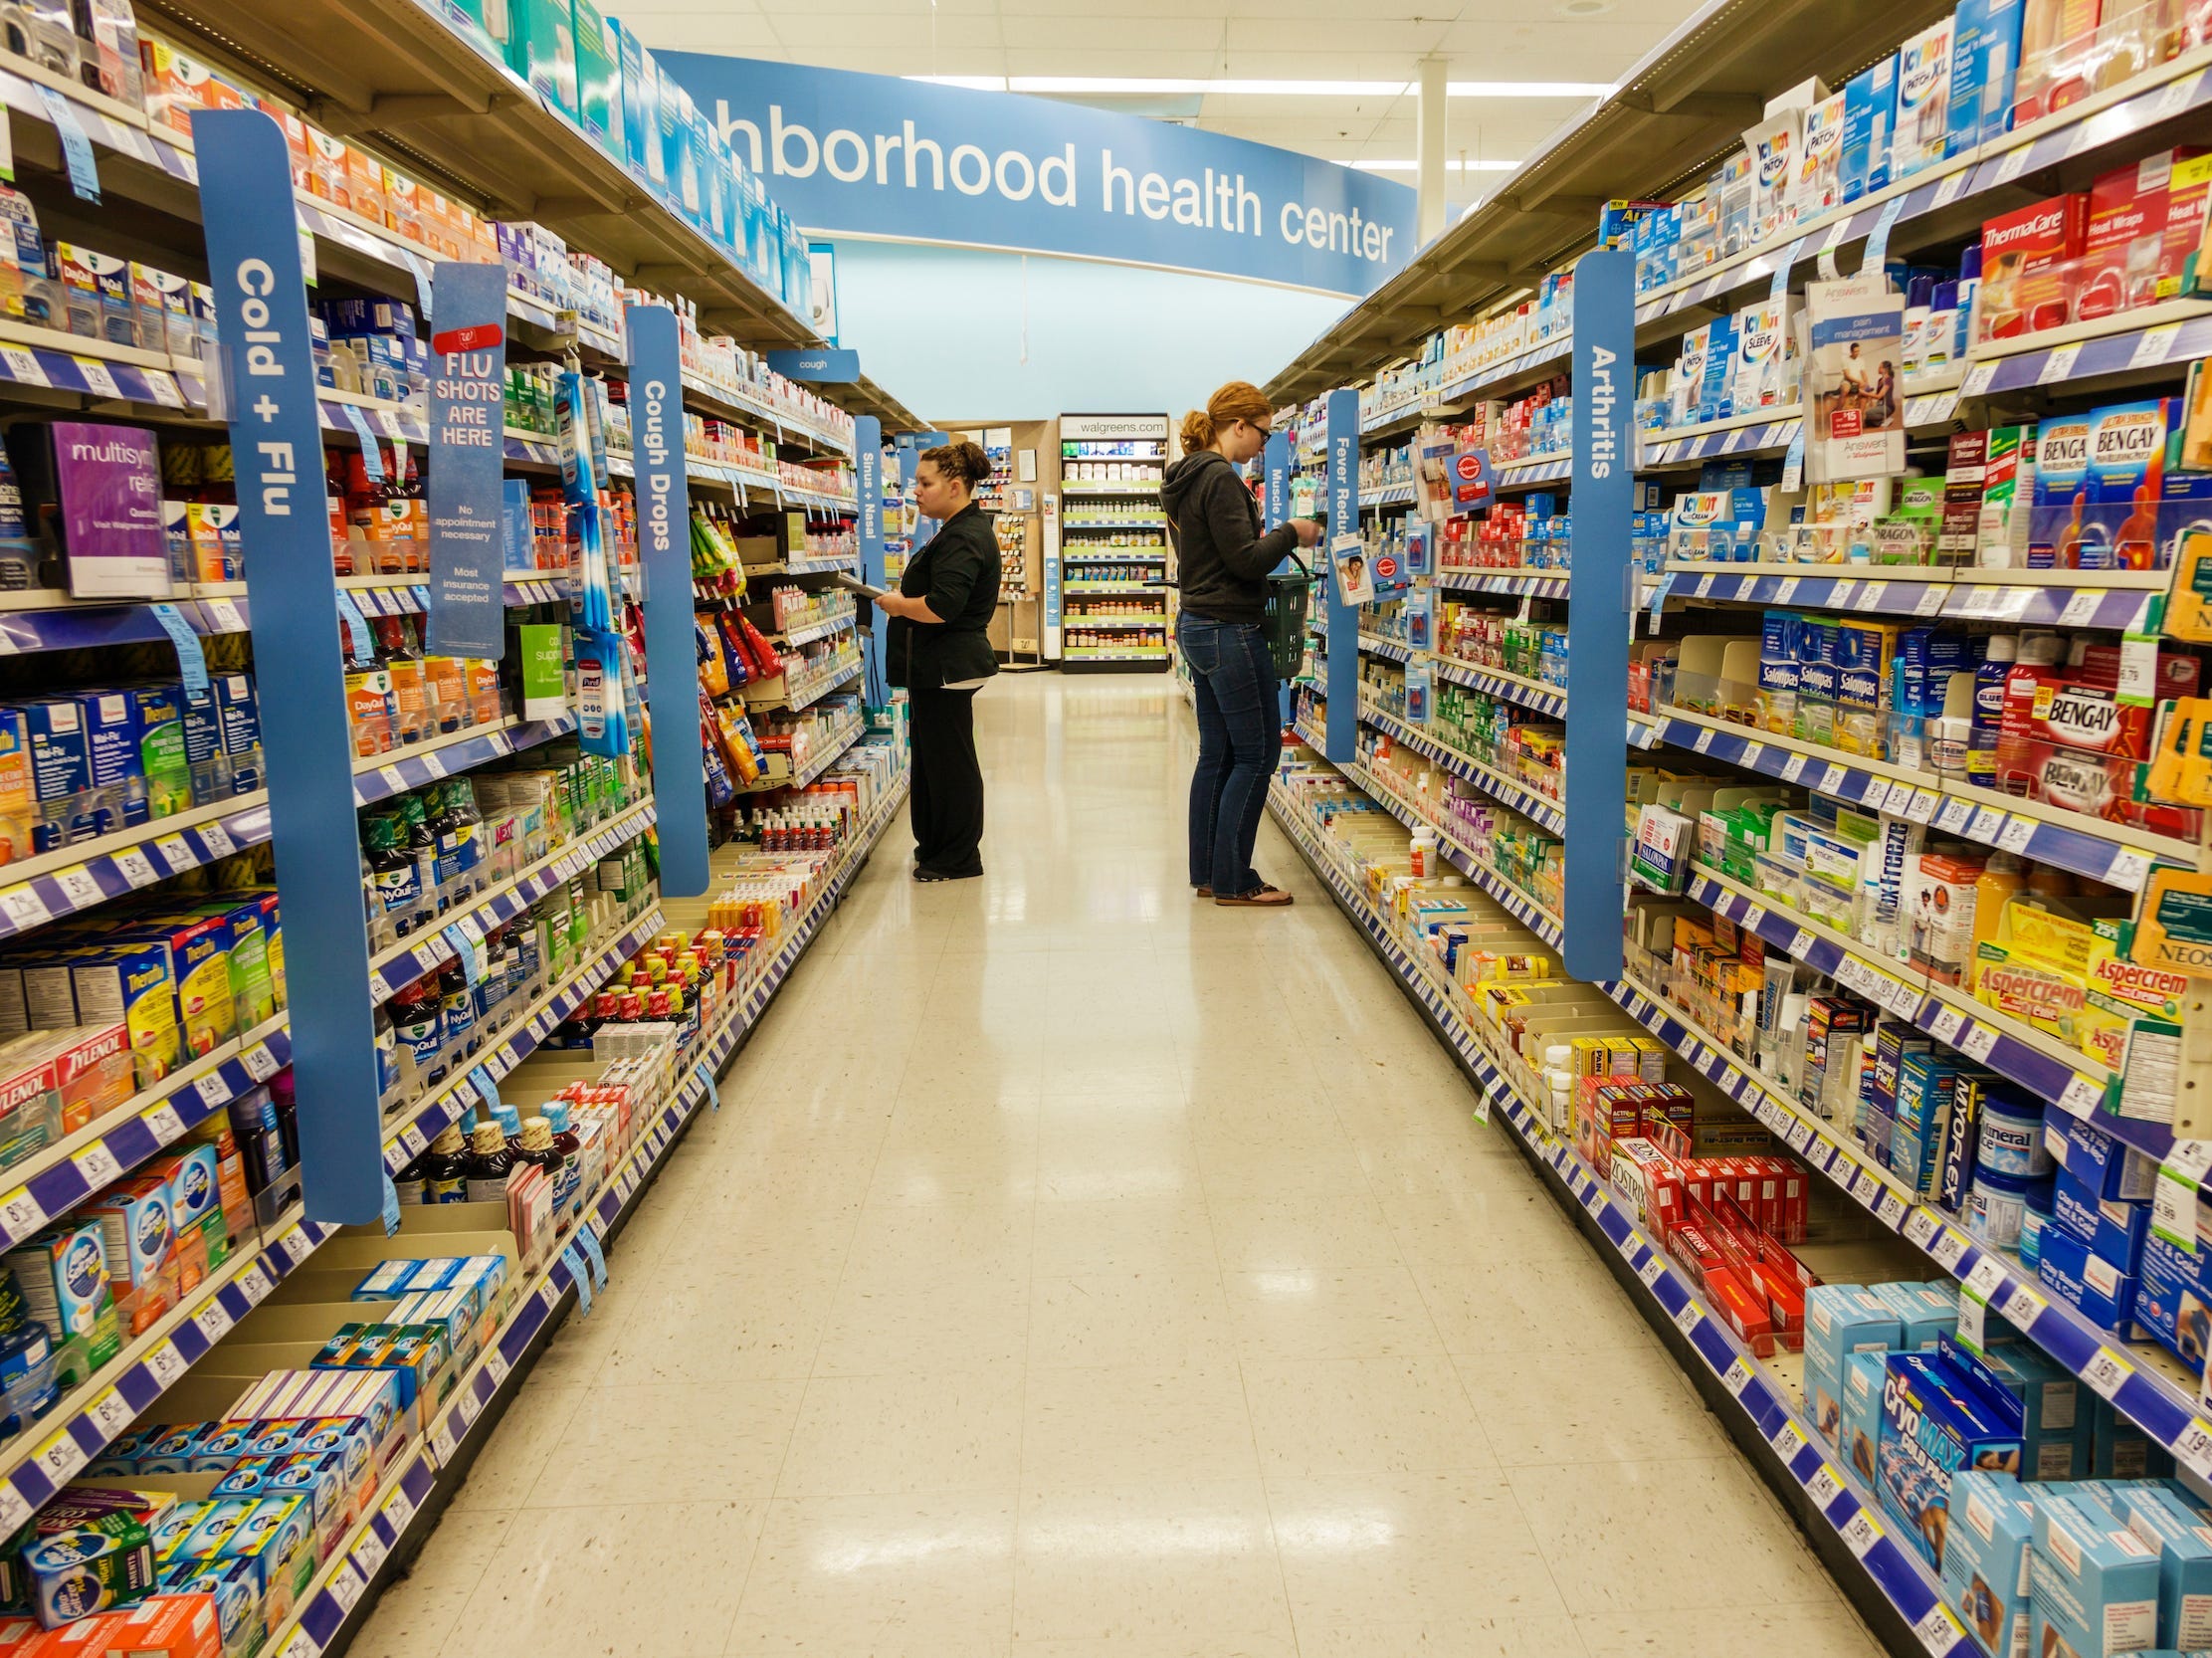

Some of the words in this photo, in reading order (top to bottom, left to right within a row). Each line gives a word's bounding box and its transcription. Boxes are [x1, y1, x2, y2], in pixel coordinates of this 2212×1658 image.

[1930, 58, 1948, 80] XL
[1103, 149, 1262, 237] health
[1280, 202, 1394, 264] center
[1984, 209, 2064, 249] ThermaCare
[237, 258, 286, 376] Cold
[1852, 316, 1872, 329] pain
[1748, 334, 1772, 349] SLEEVE
[1834, 324, 1892, 341] management
[445, 352, 493, 379] FLU
[799, 358, 828, 370] cough
[436, 380, 501, 402] SHOTS
[449, 406, 487, 425] ARE
[643, 380, 670, 465] Cough
[1591, 344, 1617, 480] Arthritis
[441, 426, 493, 447] HERE
[1081, 422, 1163, 435] walgreens.com
[2097, 426, 2159, 453] BENGAY
[1844, 439, 1888, 452] Answers
[863, 452, 875, 490] Sinus
[1336, 437, 1350, 484] Fever
[257, 441, 297, 516] Flu
[1272, 469, 1283, 515] Muscle
[1905, 495, 1932, 504] DRAGON
[458, 505, 474, 516] No
[648, 474, 671, 551] Drops
[865, 503, 877, 539] Nasal
[435, 518, 497, 529] appointment
[441, 531, 491, 543] necessary
[454, 567, 479, 578] Most
[443, 579, 491, 591] insurance
[444, 592, 490, 604] accepted
[1762, 666, 1799, 689] Salonpas
[1800, 666, 1834, 690] Salonpas
[1840, 673, 1876, 698] Salonpas
[2049, 699, 2118, 731] BENGAY
[67, 1034, 121, 1081] TYLENOL
[1876, 1055, 1897, 1076] Joint
[1900, 1073, 1924, 1096] Joint
[1944, 1079, 1970, 1206] MYOFLEX
[1611, 1158, 1646, 1209] ZOSTRIX
[1884, 1378, 1967, 1475] CryoMAX
